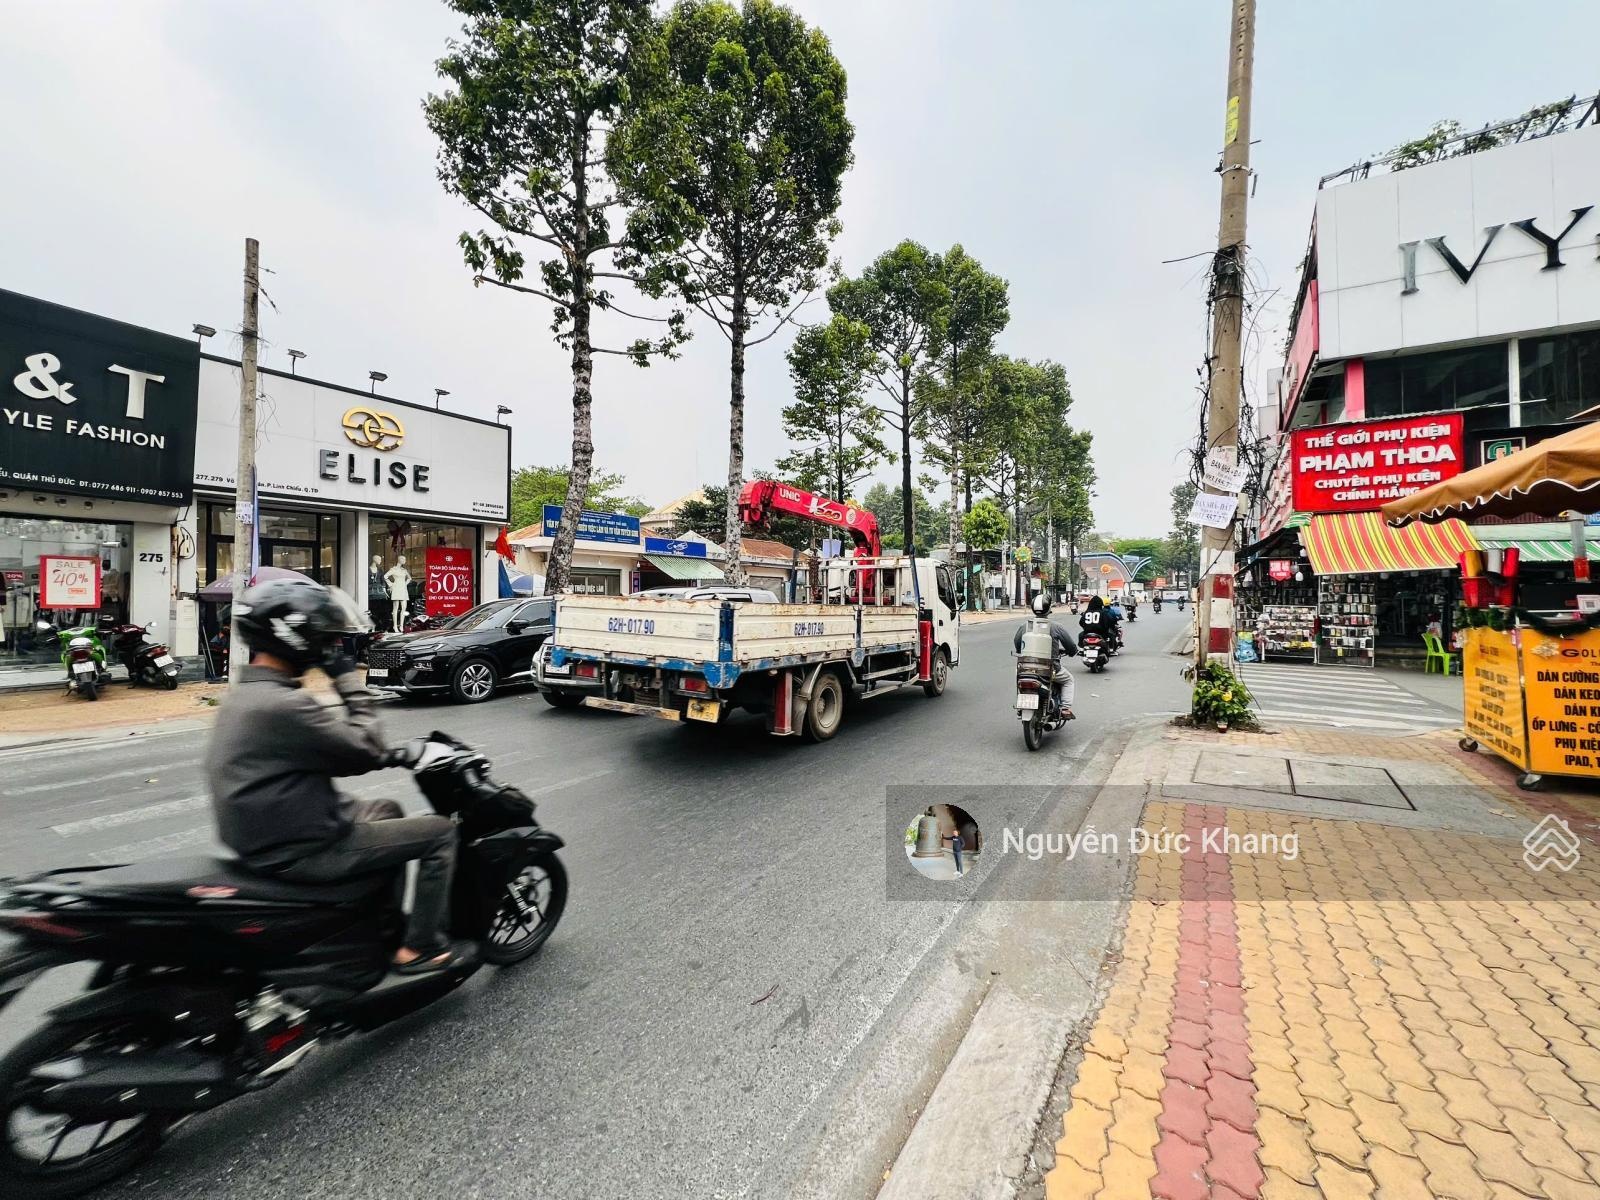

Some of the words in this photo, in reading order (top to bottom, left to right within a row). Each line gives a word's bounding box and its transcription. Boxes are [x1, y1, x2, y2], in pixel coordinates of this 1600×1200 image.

[1398, 203, 1600, 296] IVY
[13, 352, 77, 405] &
[107, 363, 165, 420] T
[65, 419, 165, 449] FASHION
[1305, 430, 1336, 448] THẾ
[1337, 429, 1371, 446] GIỚI
[1373, 428, 1407, 443] PHỤ
[1410, 423, 1450, 440] KIỆN
[1300, 450, 1374, 475] PHẠM
[1380, 444, 1457, 467] THOA
[12, 471, 38, 482] QUẬN
[40, 474, 56, 483] THỦ
[319, 448, 430, 493] ELISE
[1314, 475, 1370, 489] CHUYÊN
[1372, 474, 1403, 485] PHỤ
[1406, 469, 1441, 484] KIỆN
[779, 487, 801, 502] UNIC
[1333, 487, 1376, 501] CHÍNH
[56, 560, 86, 569] SALE
[139, 552, 163, 563] 275
[53, 572, 89, 588] 40%
[429, 572, 469, 594] 50%
[1084, 611, 1101, 625] 90
[1537, 669, 1559, 682] DÁN
[1562, 669, 1599, 683] CƯỜNG
[1554, 686, 1576, 699] DÁN
[1565, 703, 1587, 716] DÁN
[1532, 716, 1546, 731] ỐP
[1549, 720, 1577, 732] LƯNG
[1555, 737, 1576, 751] PHỤ
